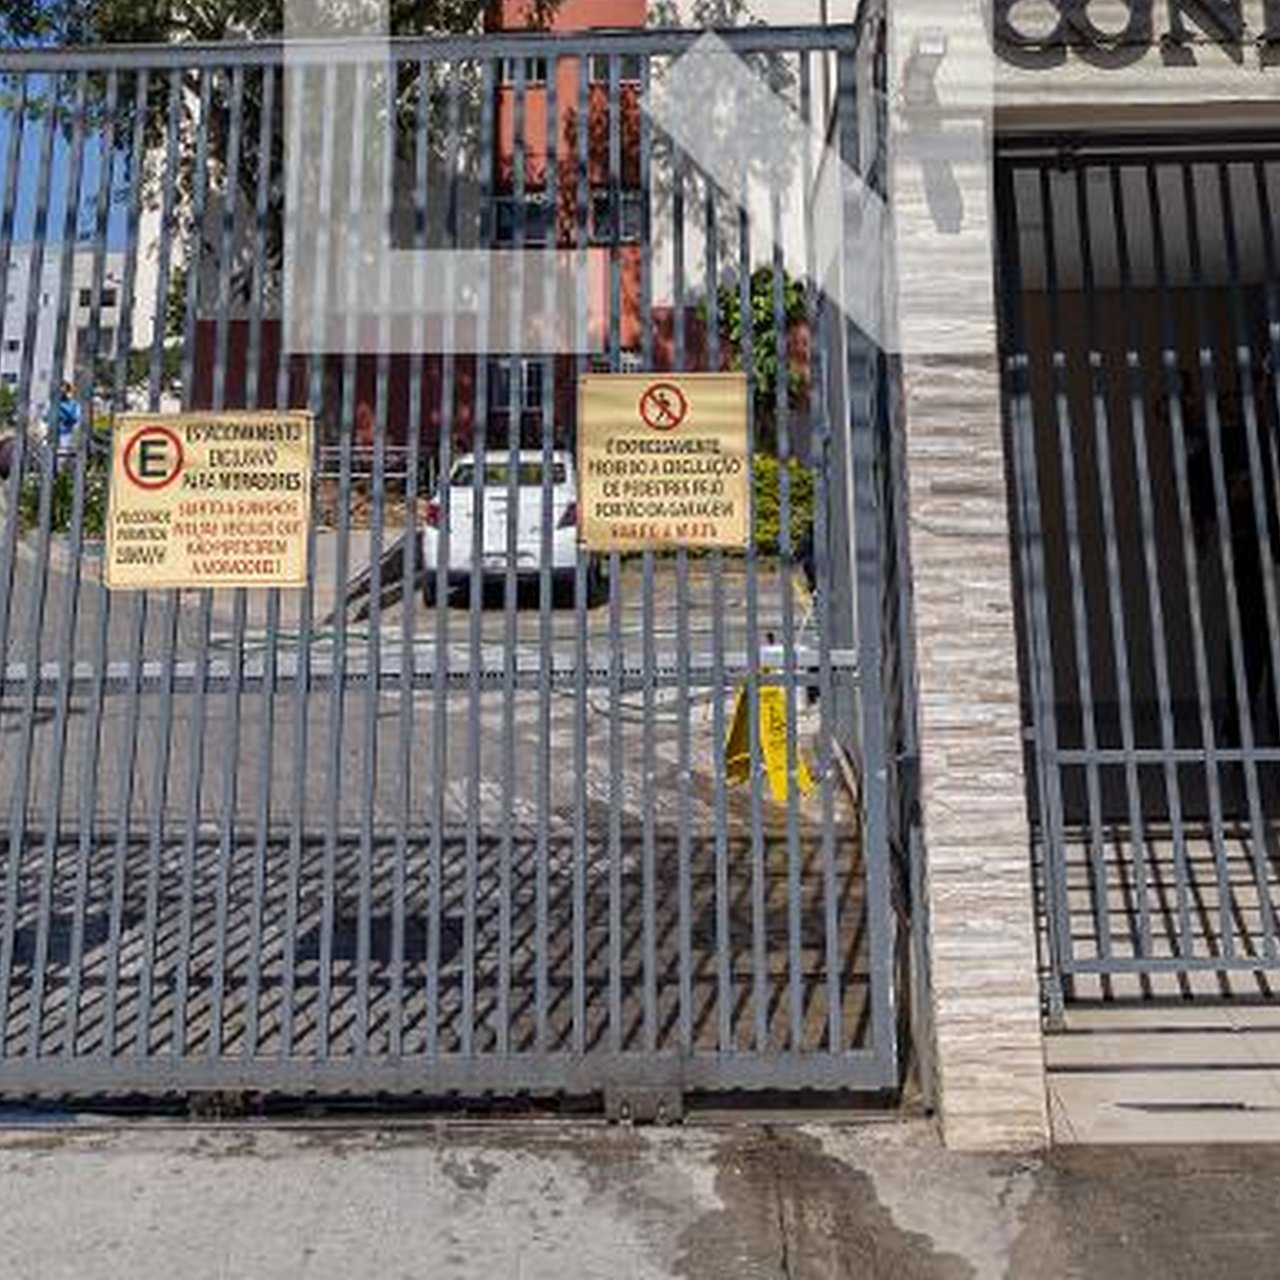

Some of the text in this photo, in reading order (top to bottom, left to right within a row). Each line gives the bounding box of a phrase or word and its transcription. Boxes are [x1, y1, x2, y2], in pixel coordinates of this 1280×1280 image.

[185, 423, 300, 442] ESTACIONAMENTO
[615, 438, 721, 455] EXPRESSAMENTE
[139, 439, 168, 477] E
[209, 447, 277, 467] EXCLUSIVO
[588, 456, 742, 477] PROIBIDO A CIRCULAÇÃO
[183, 472, 301, 490] PARA MORADORES
[602, 480, 724, 498] DE PEDESTRES PELO
[595, 500, 646, 518] PORTÃO
[666, 501, 734, 518] GARAGEM
